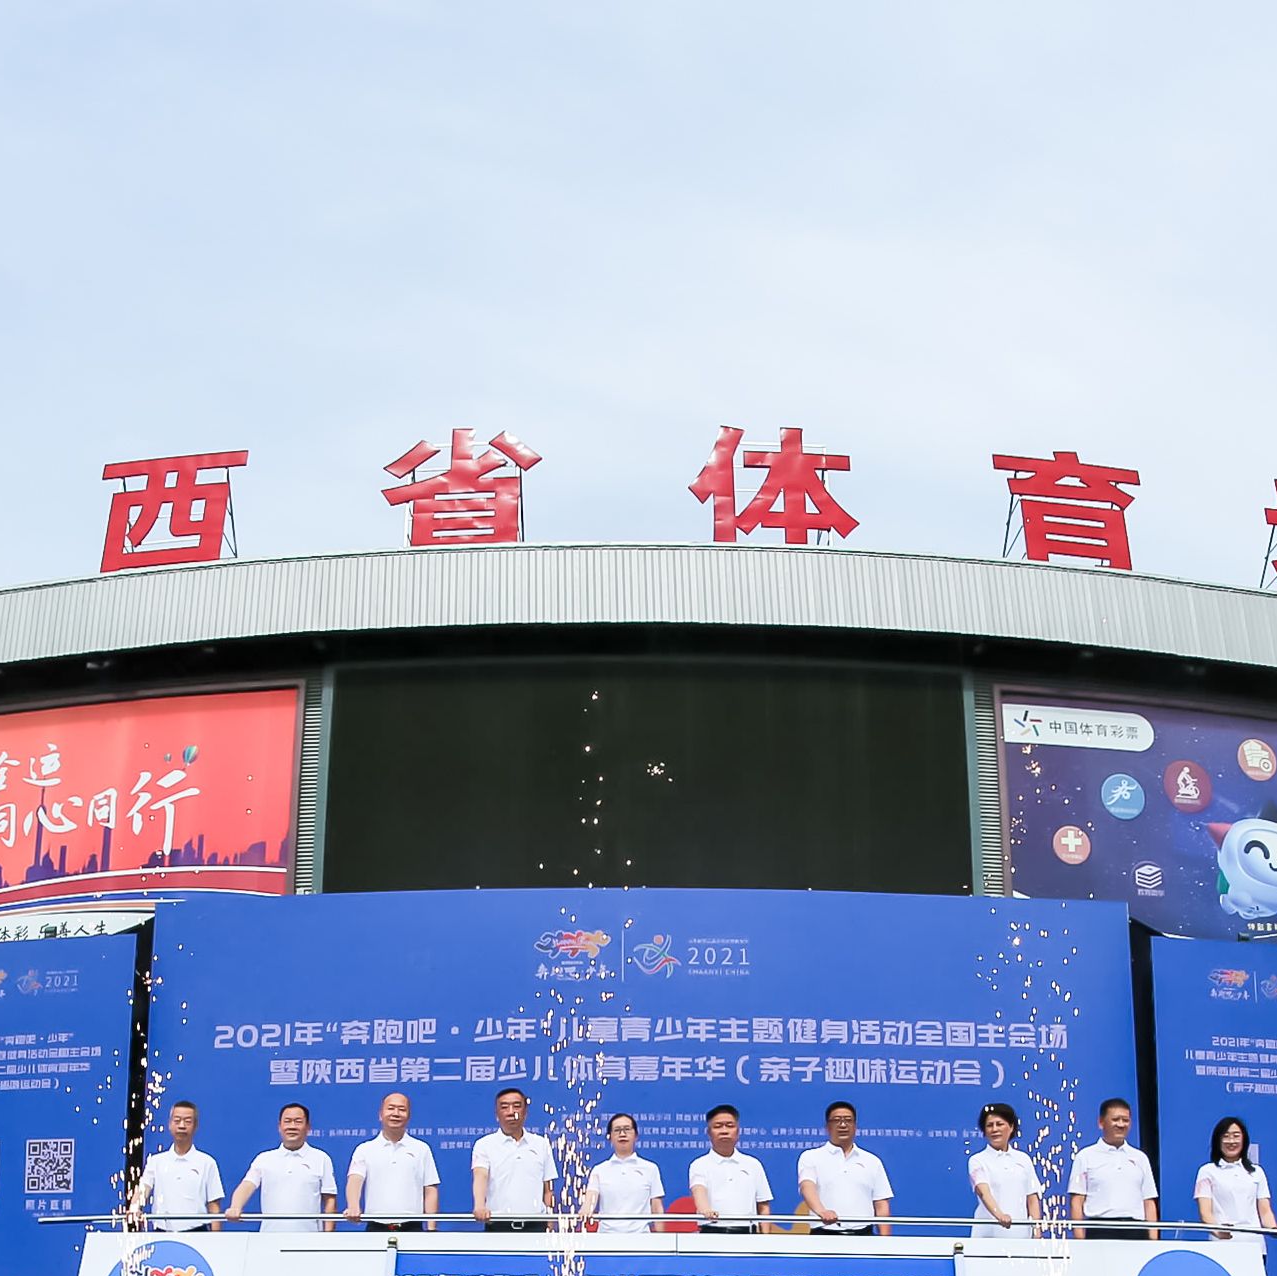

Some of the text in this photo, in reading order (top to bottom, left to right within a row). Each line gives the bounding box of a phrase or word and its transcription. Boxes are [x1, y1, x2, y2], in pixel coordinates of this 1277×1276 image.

[1049, 719, 1139, 740] 中国体育彩票
[688, 947, 750, 965] 2021
[45, 975, 79, 988] 2021
